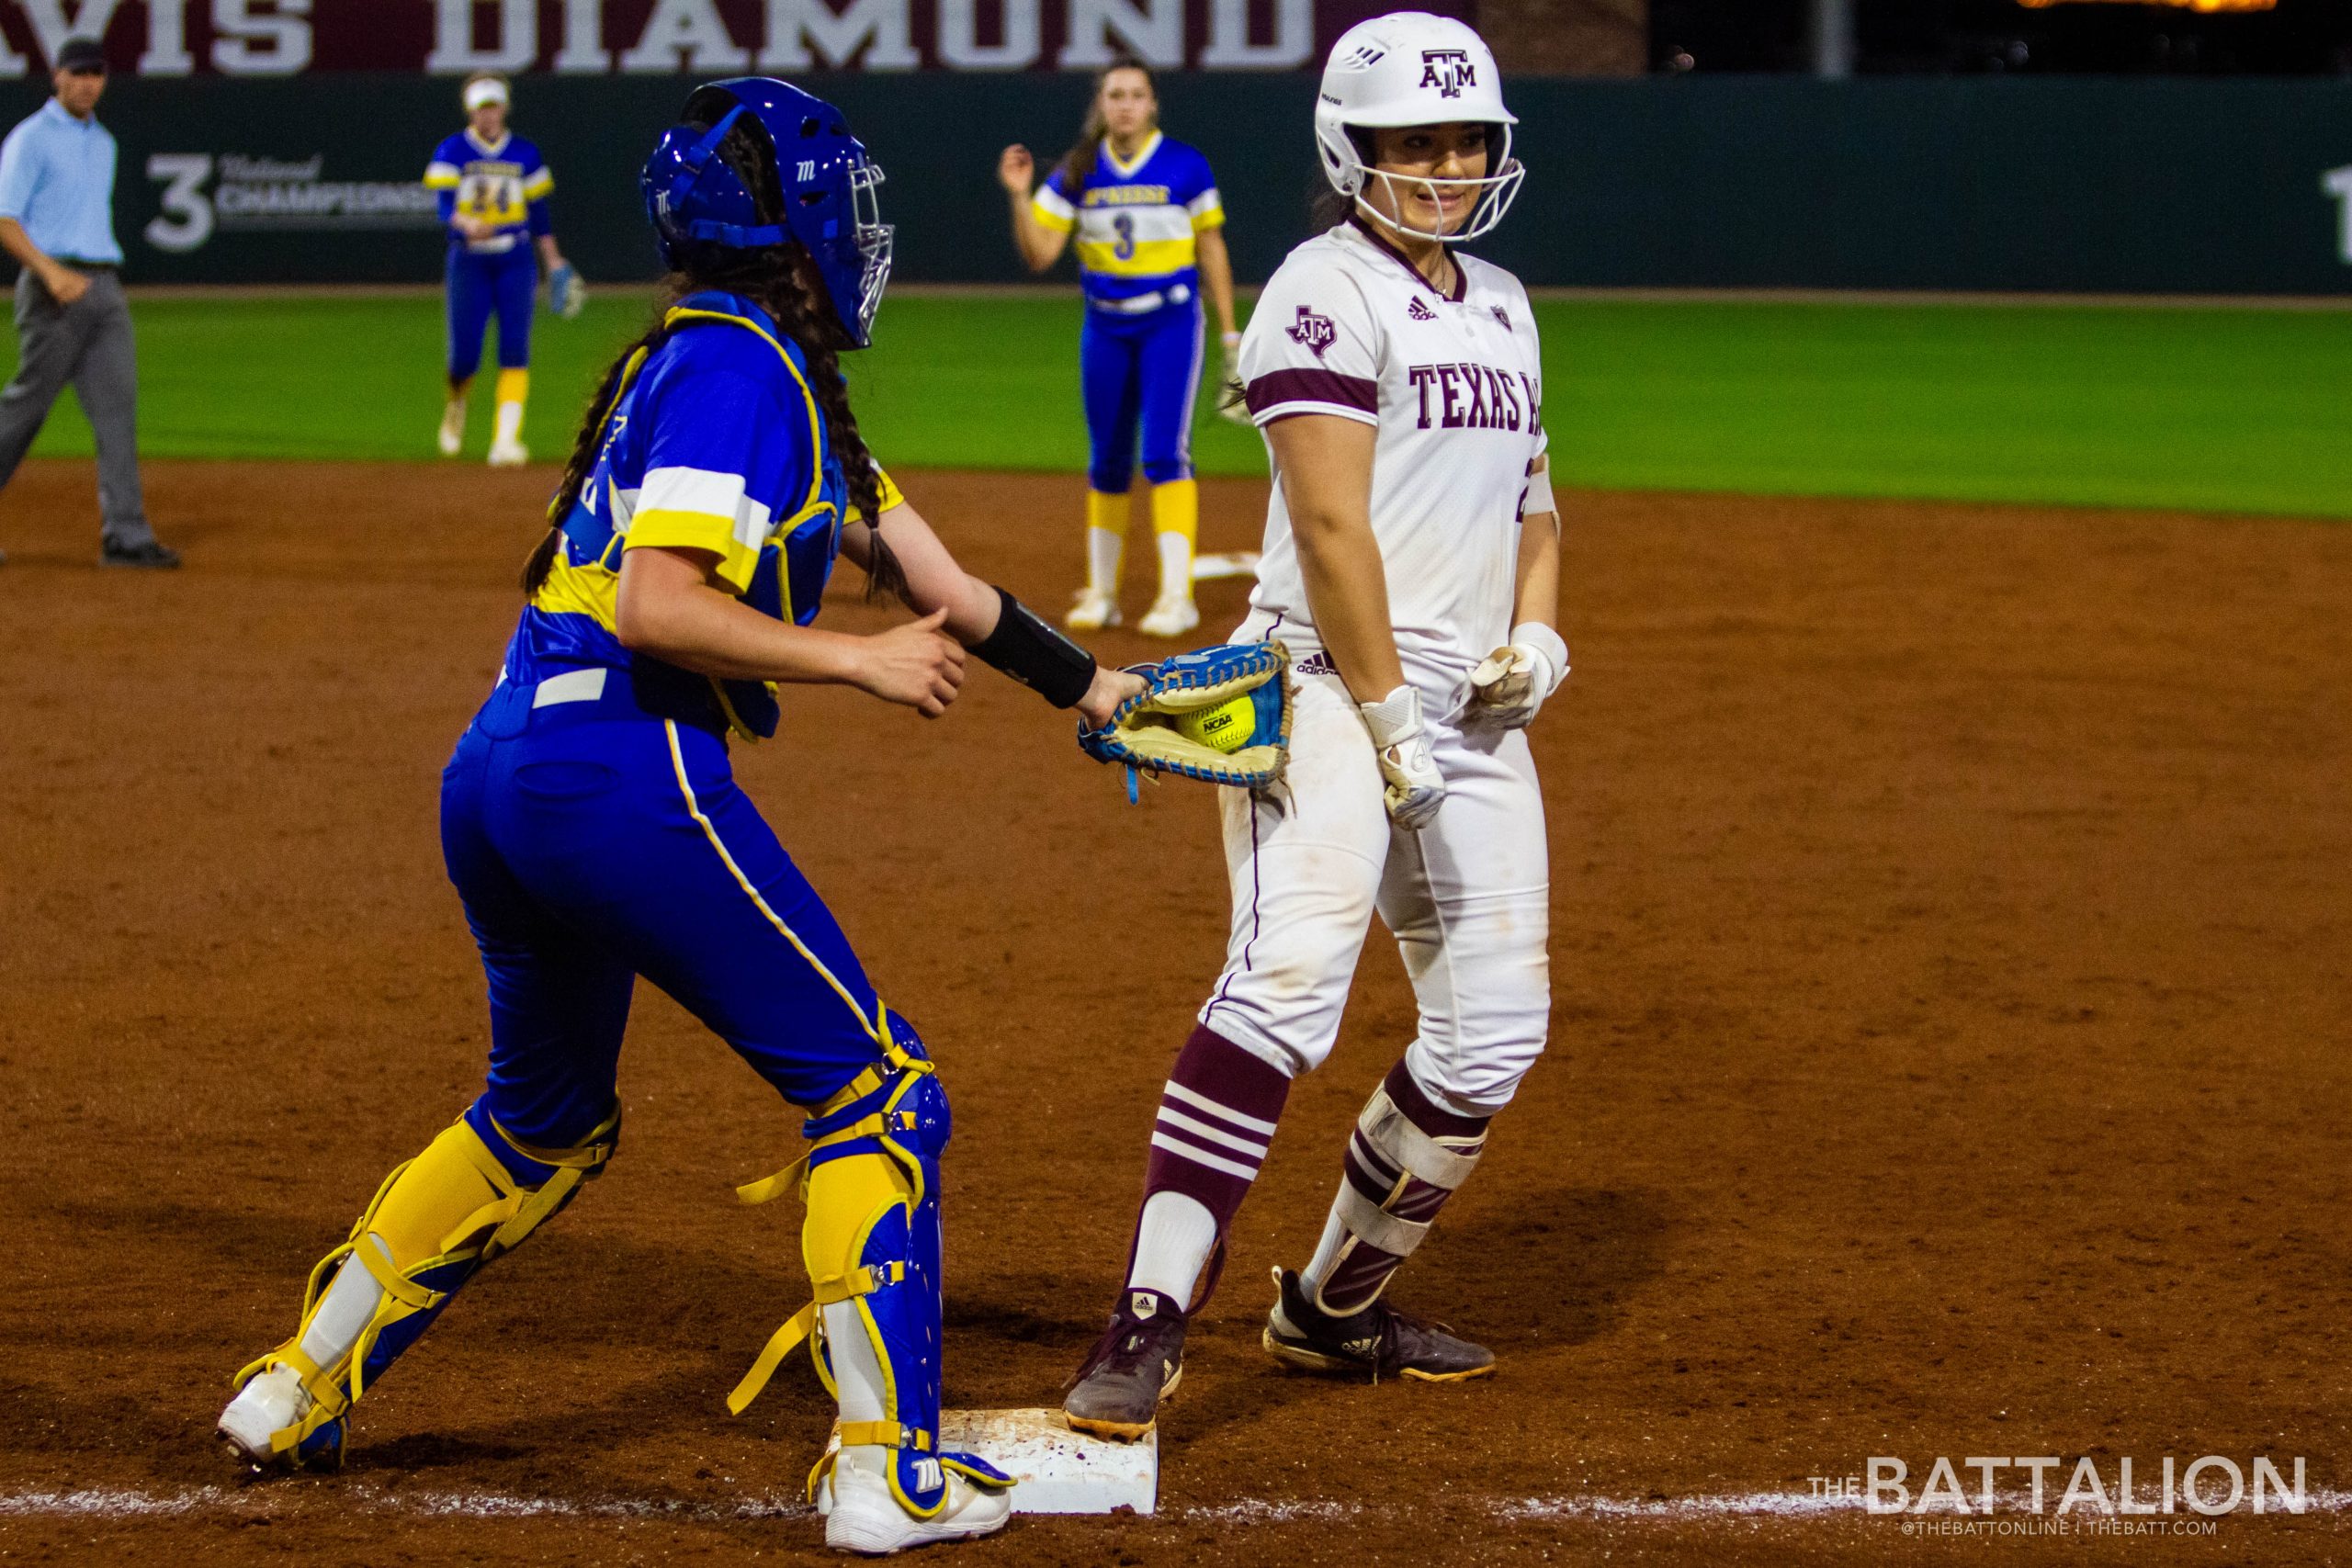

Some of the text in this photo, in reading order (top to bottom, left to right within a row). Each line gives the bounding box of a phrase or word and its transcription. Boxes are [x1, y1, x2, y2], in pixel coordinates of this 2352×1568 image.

[0, 0, 1315, 75] VIS DIAMOND
[144, 153, 213, 252] 3
[1114, 212, 1134, 261] 3
[1408, 363, 1521, 432] TEXAS
[1204, 714, 1232, 732] NCAA
